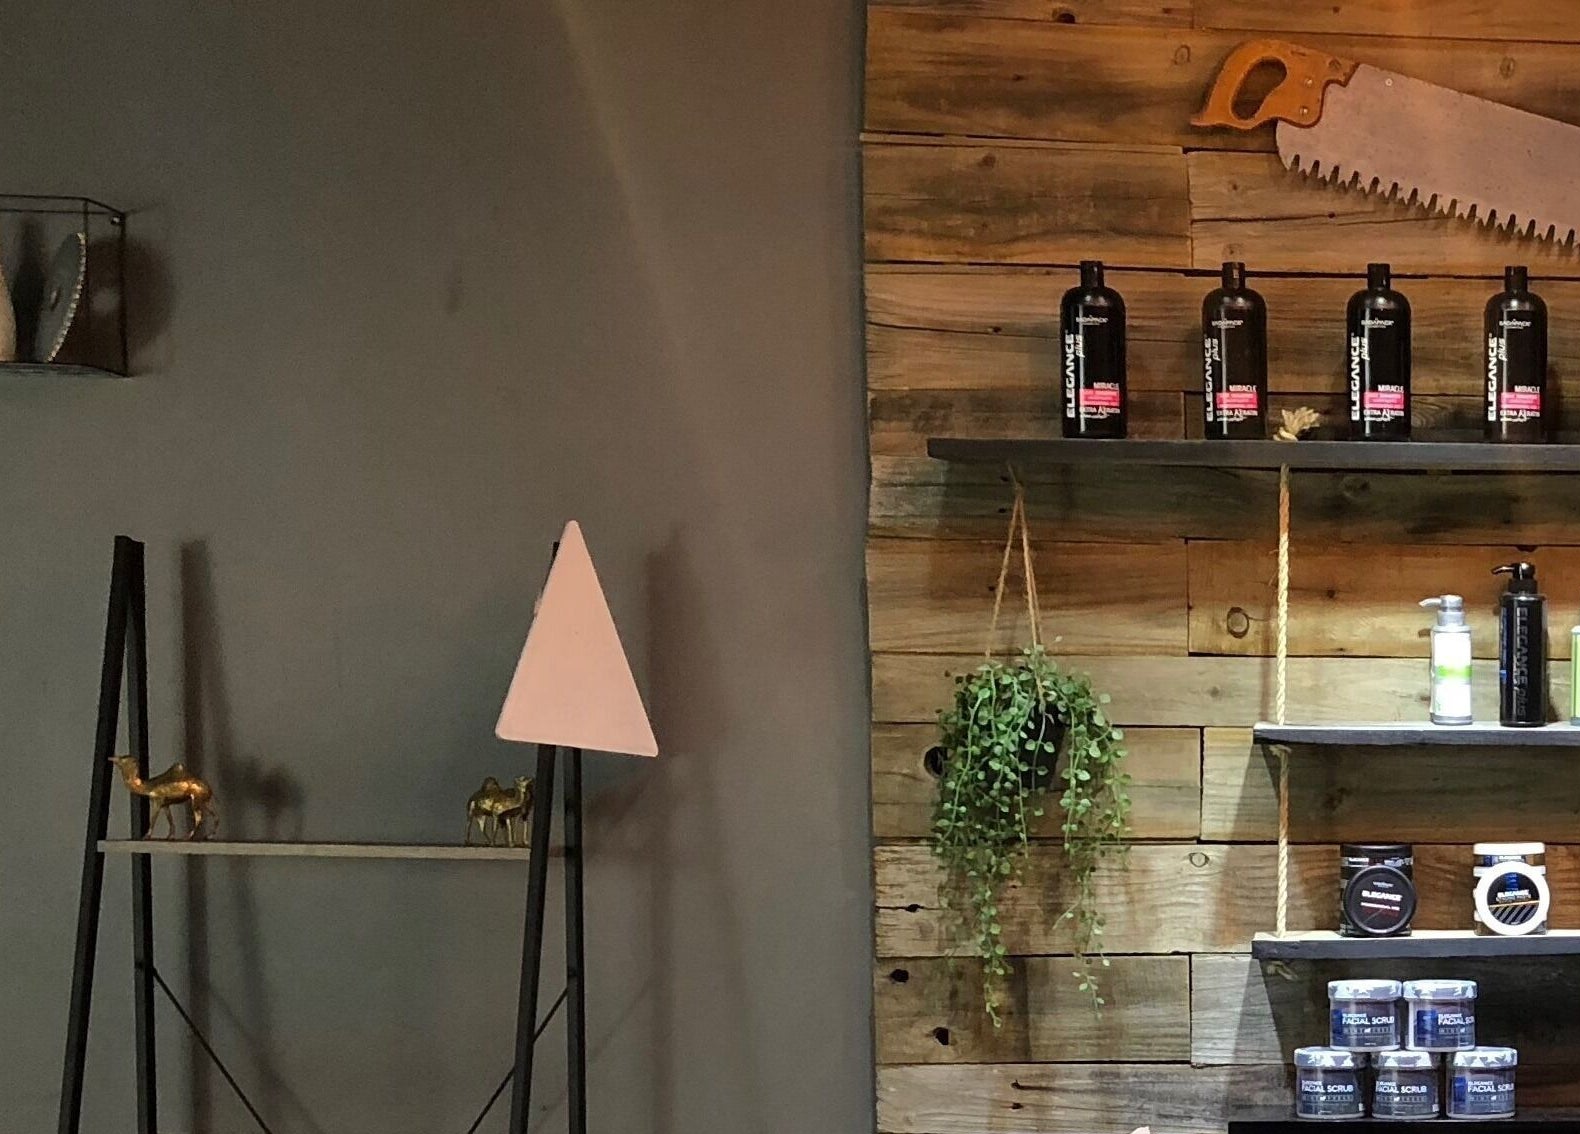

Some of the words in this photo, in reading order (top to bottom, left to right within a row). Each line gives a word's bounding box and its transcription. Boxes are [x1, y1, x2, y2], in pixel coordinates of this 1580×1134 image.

[1064, 332, 1076, 419] ELEGANCE
[1203, 337, 1214, 422] ELEGANCE
[1350, 336, 1361, 421] ELEGANCE
[1487, 336, 1498, 422] ELEGANCE
[1342, 1016, 1370, 1025] FACIAL
[1371, 1015, 1395, 1024] SCRUB
[1437, 1016, 1465, 1026] FACIAL
[1327, 1084, 1353, 1093] SCRUB
[1401, 1085, 1427, 1094] SCRUB
[1467, 1085, 1496, 1093] FACIAL
[1497, 1083, 1514, 1092] SCRU
